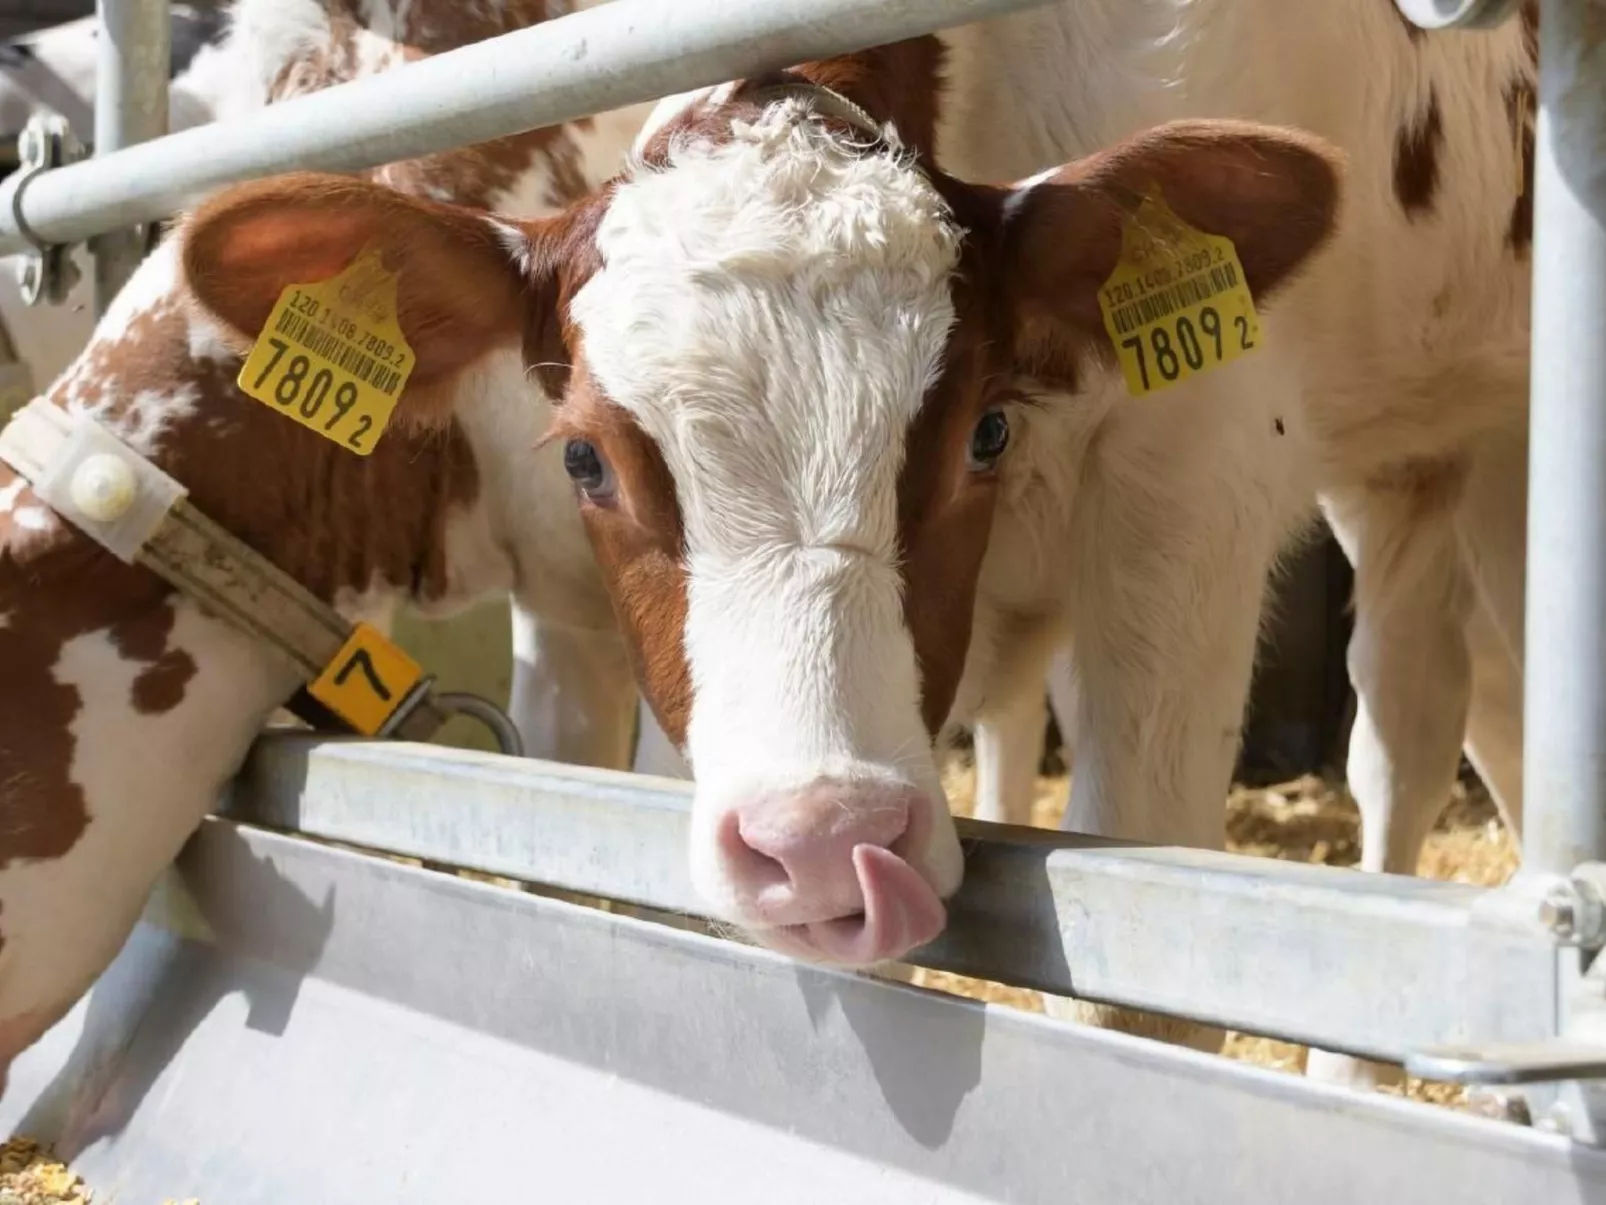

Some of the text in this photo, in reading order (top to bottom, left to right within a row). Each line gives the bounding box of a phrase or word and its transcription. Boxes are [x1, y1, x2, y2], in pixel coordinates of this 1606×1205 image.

[1121, 306, 1254, 391] 7809 2
[252, 337, 373, 449] 7809 2
[333, 646, 392, 702] 7
